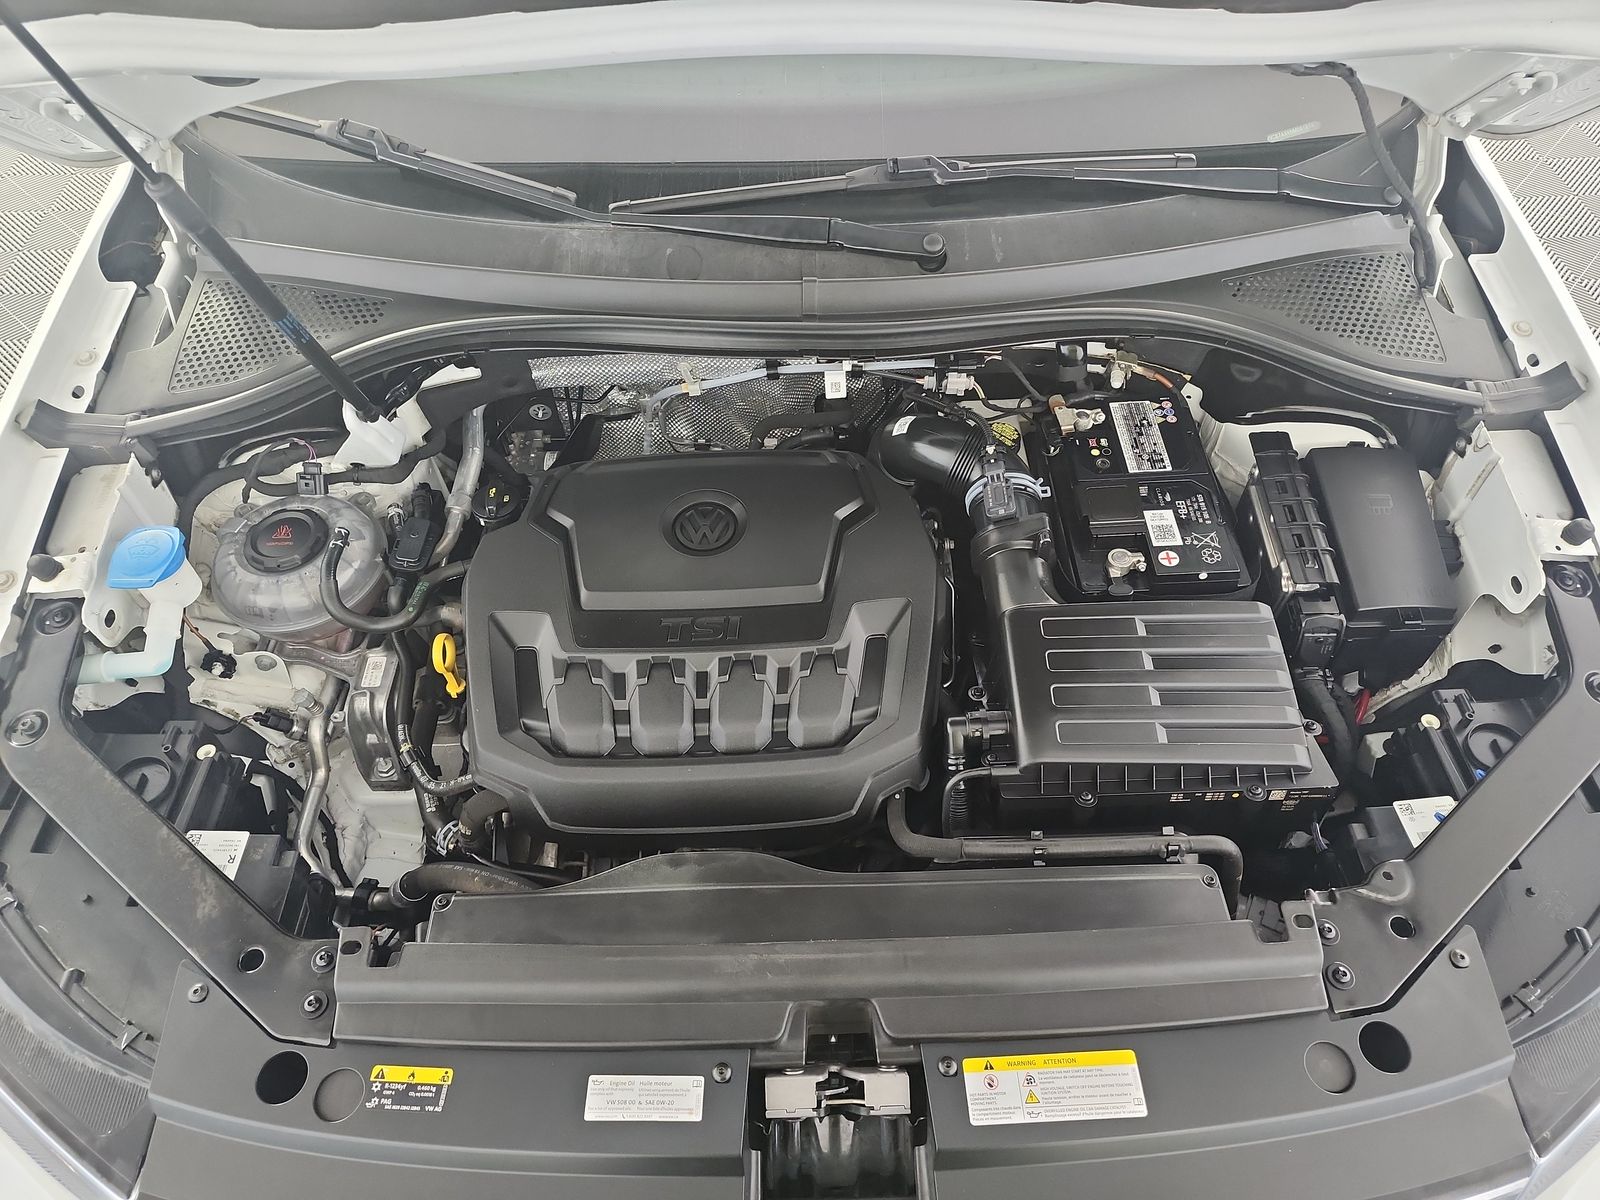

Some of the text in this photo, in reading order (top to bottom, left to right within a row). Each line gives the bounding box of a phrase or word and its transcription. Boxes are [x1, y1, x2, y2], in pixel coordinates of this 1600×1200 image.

[1176, 500, 1188, 519] EFB+
[1184, 536, 1192, 545] Pb
[660, 615, 743, 643] TSI
[228, 854, 236, 864] R
